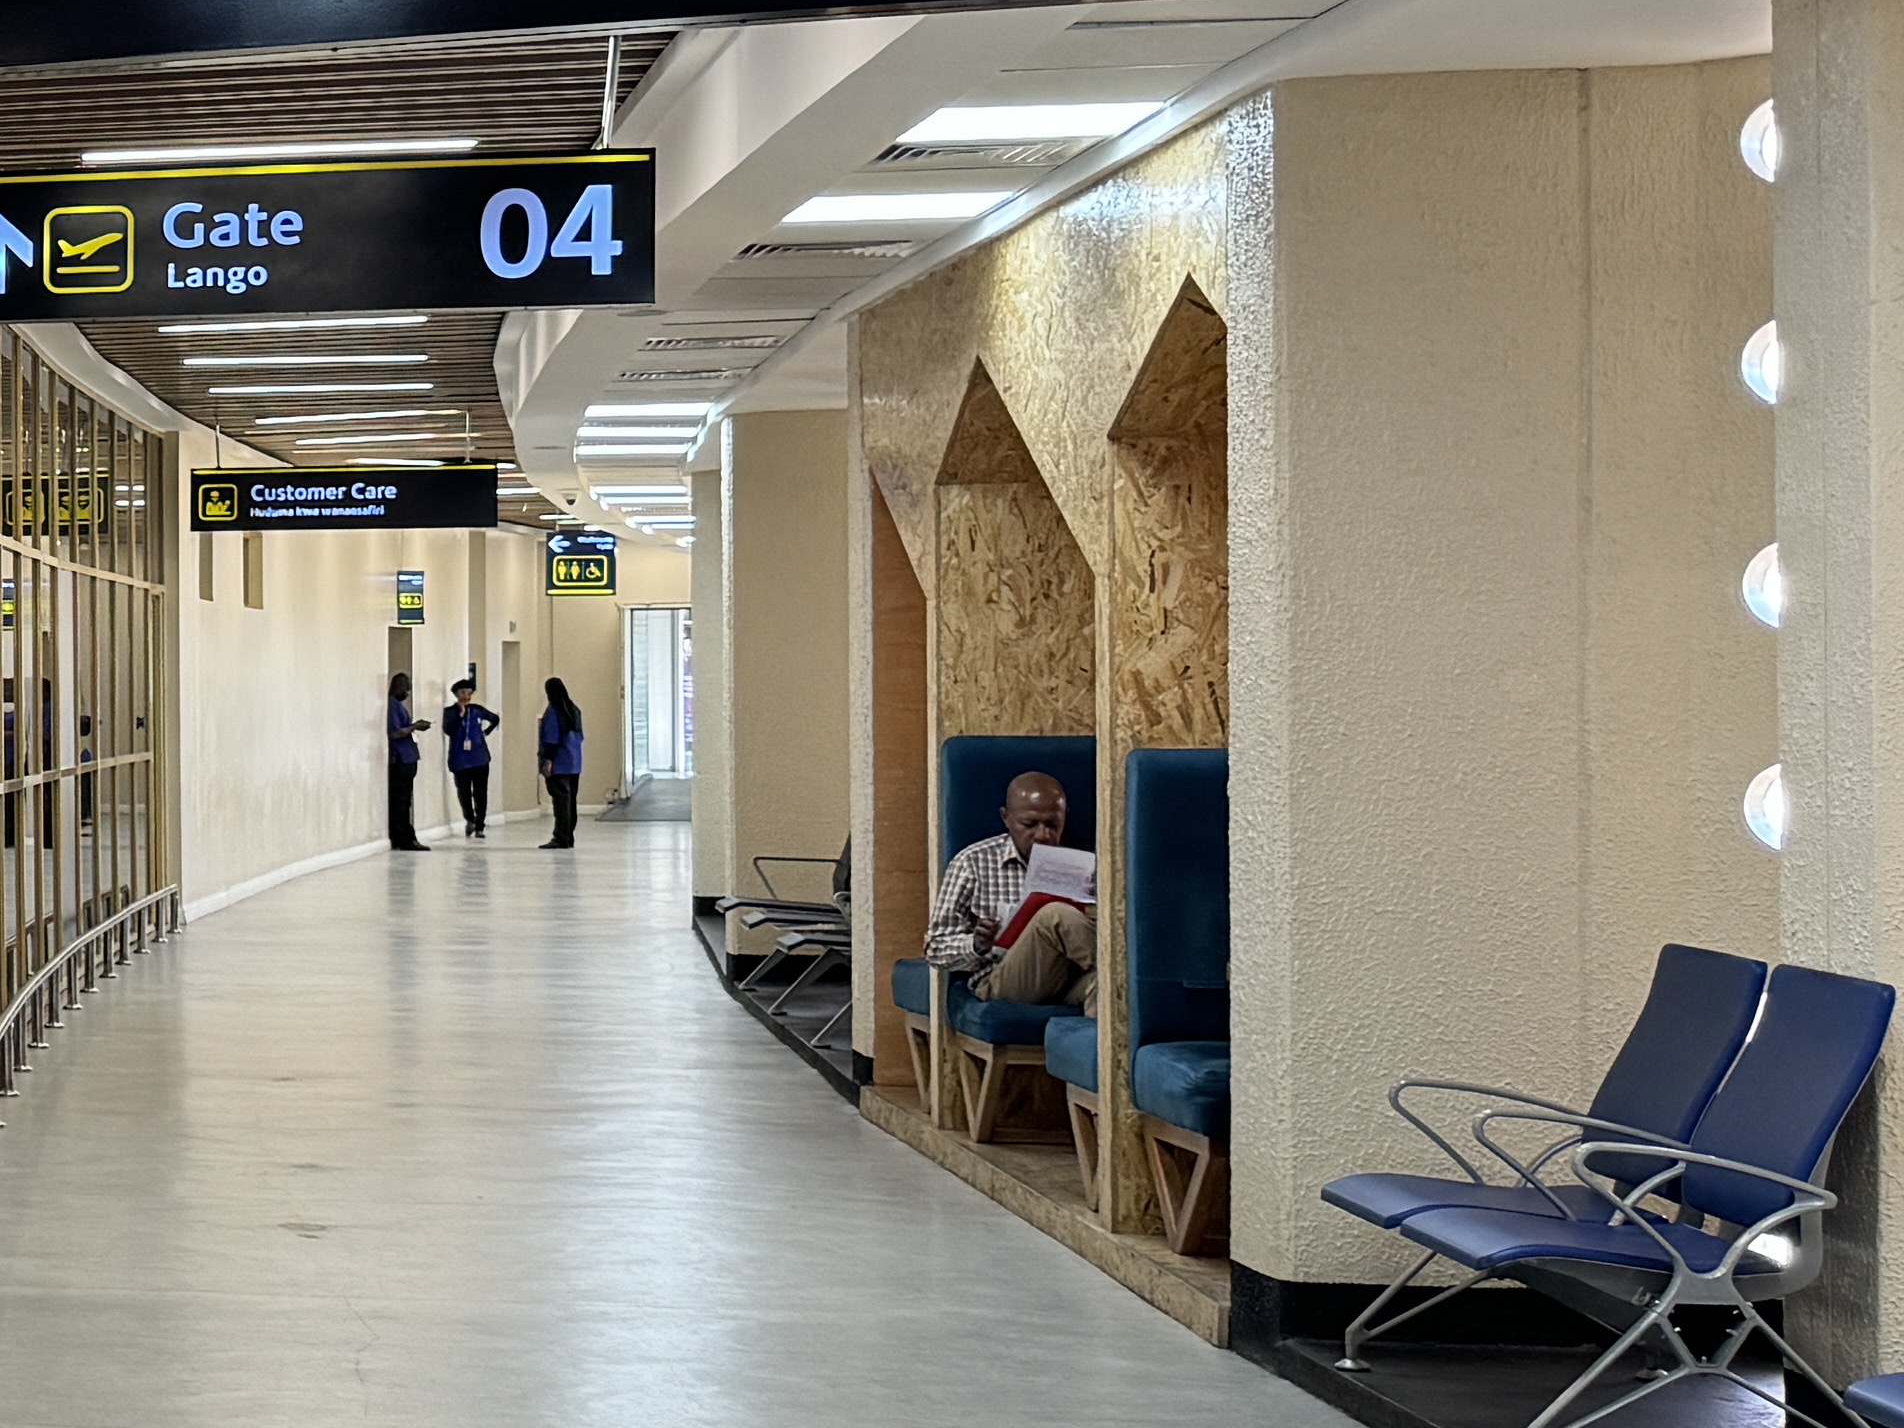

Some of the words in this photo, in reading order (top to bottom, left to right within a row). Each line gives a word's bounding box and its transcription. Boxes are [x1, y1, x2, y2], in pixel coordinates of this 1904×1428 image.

[163, 202, 303, 248] Gate
[480, 184, 623, 279] 04
[168, 263, 268, 294] Lango
[251, 485, 347, 501] Customer
[351, 483, 397, 499] Care
